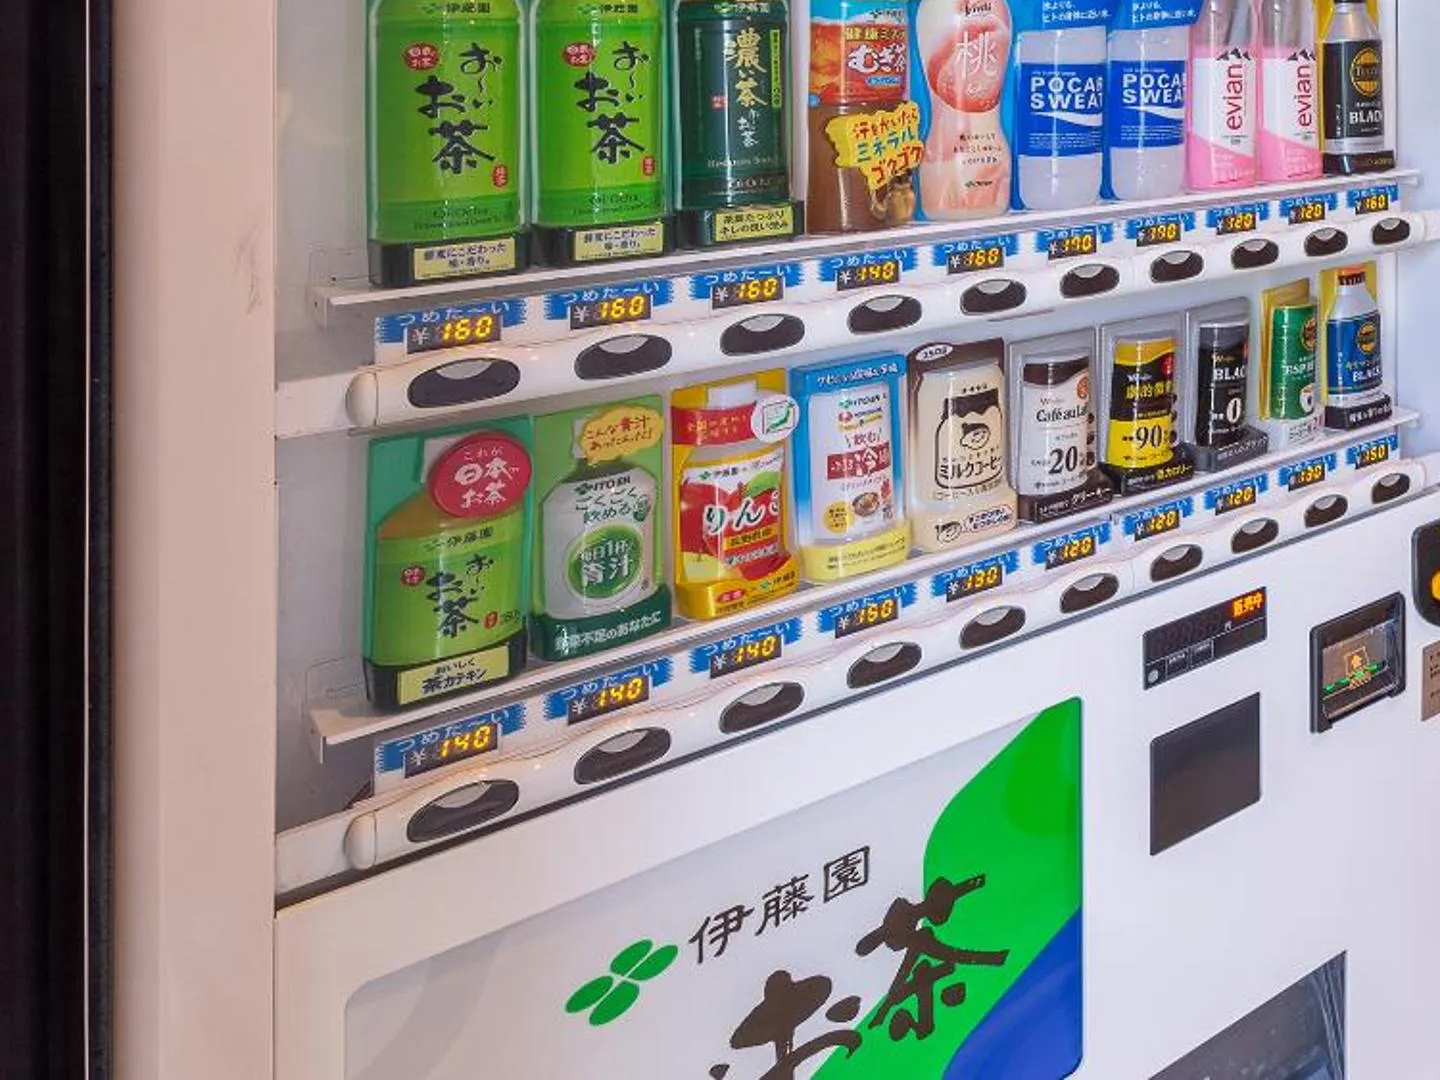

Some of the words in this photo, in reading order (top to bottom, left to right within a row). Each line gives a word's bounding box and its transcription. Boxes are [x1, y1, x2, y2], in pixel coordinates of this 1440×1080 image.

[953, 30, 998, 81] 桃
[1226, 61, 1243, 131] evian
[1297, 63, 1312, 129] evian
[415, 74, 495, 175] お茶
[575, 71, 645, 165] お茶
[856, 128, 916, 163] ミネラル
[870, 144, 925, 185] ゴクゴク
[1226, 398, 1242, 423] 0
[1136, 425, 1162, 449] 90
[939, 456, 1004, 481] ミルクコーヒ
[1050, 446, 1077, 474] 20
[460, 482, 507, 508] お茶
[689, 845, 870, 965] 伊藤園
